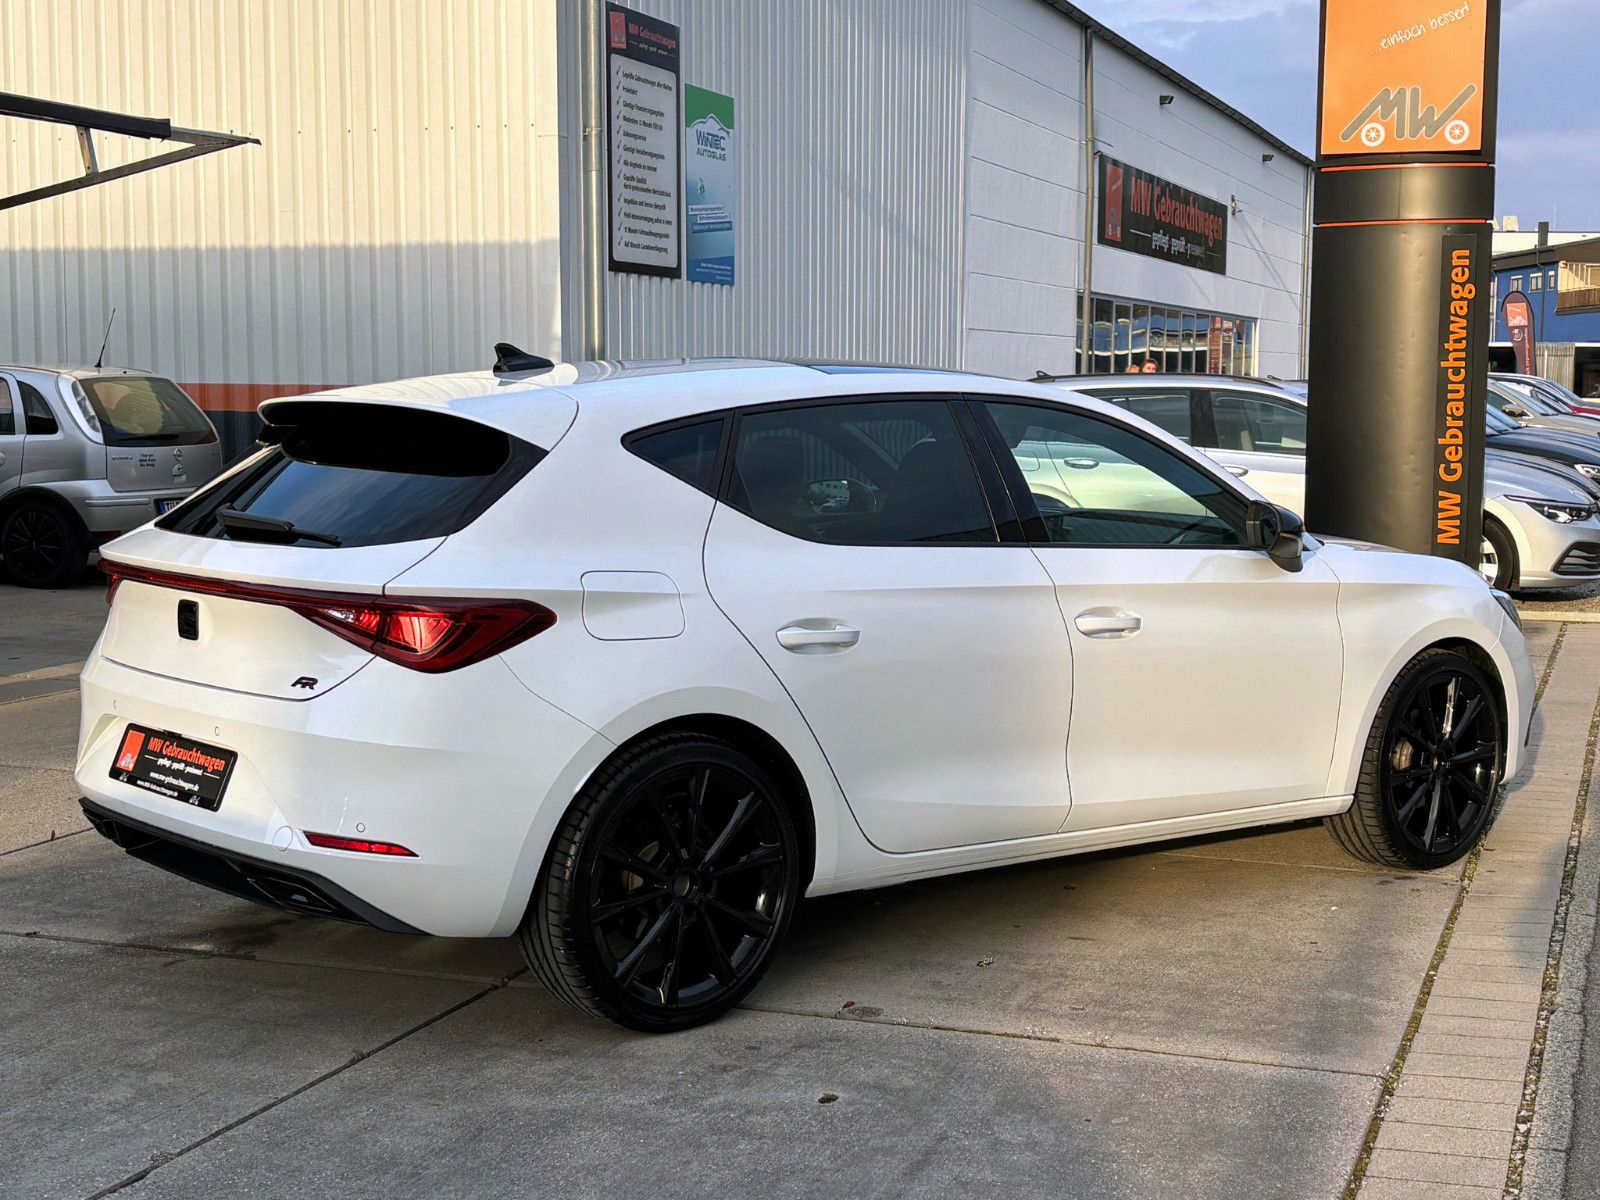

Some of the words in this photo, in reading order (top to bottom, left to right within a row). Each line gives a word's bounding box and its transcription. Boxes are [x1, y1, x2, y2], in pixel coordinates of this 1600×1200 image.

[1340, 84, 1477, 143] MW
[1130, 176, 1152, 217] MW
[1154, 184, 1223, 248] Gebrauchtwagen
[1438, 249, 1476, 482] Gebrauchtwagen
[1437, 490, 1461, 545] MW
[147, 737, 163, 753] MW
[162, 742, 226, 773] Gebrauchtwagen
